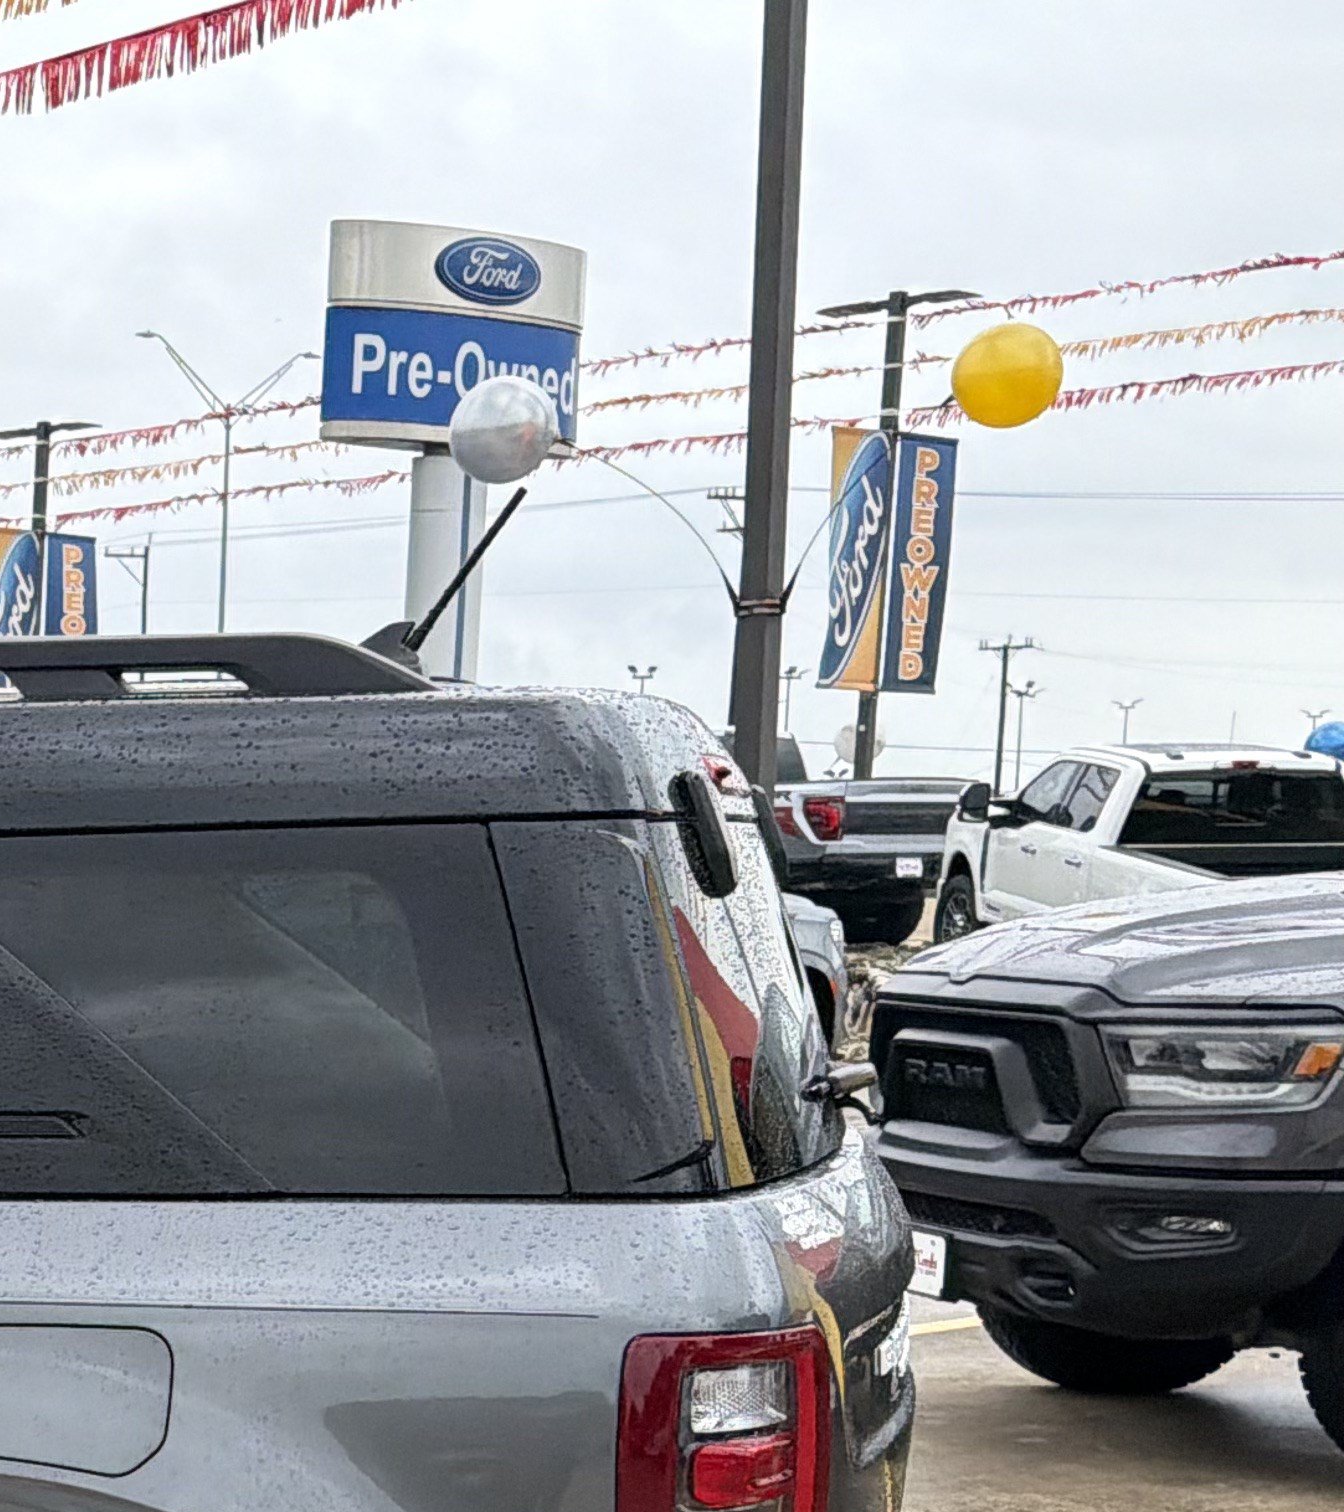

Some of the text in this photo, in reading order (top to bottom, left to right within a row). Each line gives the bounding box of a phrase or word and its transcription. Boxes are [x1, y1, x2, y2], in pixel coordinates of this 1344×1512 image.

[463, 246, 523, 290] Ford
[60, 543, 86, 636] PREO
[829, 475, 884, 648] Ford
[898, 447, 940, 681] PREOWNED
[904, 1057, 987, 1089] RAM
